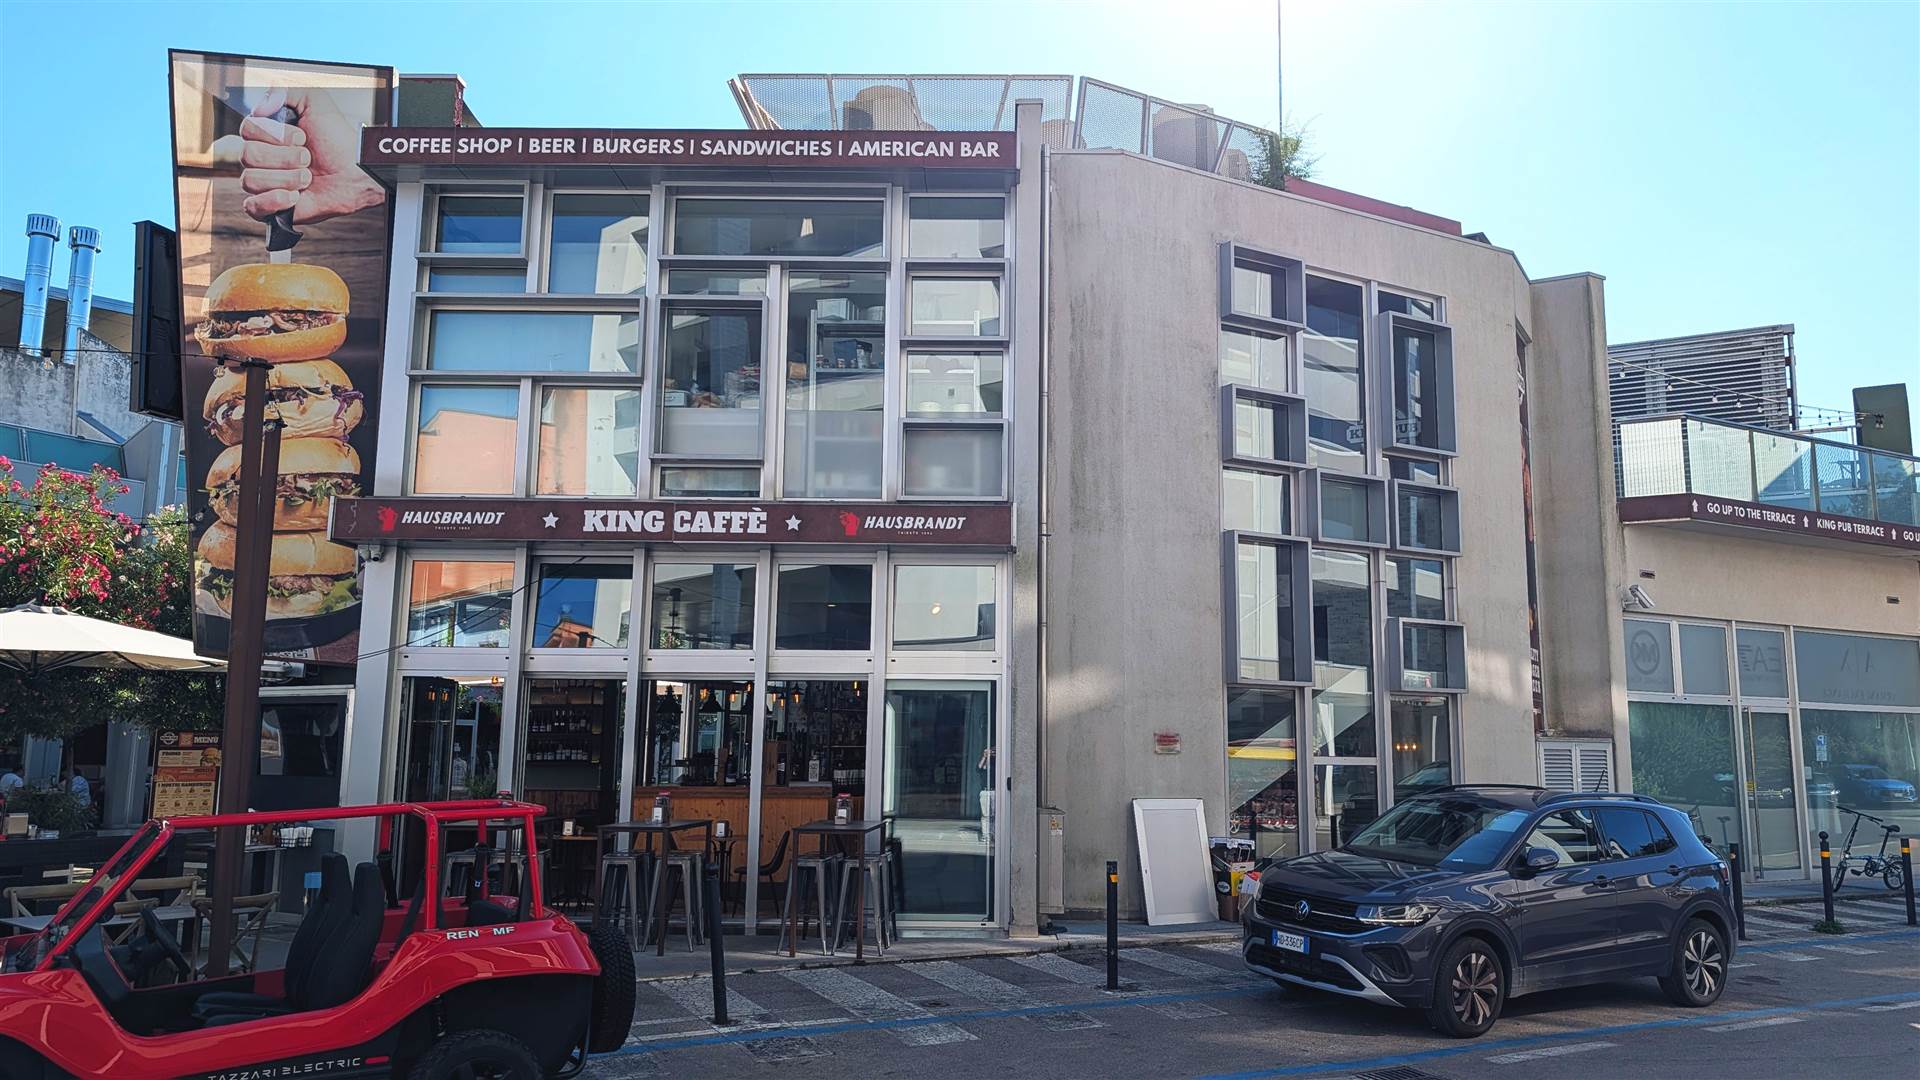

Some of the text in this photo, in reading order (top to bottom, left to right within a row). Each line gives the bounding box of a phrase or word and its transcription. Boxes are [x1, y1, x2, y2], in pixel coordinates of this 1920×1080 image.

[378, 138, 451, 154] COFFEE
[456, 137, 512, 154] SHOP
[529, 138, 576, 154] BEER
[593, 138, 684, 155] BURGERS
[700, 139, 832, 156] SANDWICHES
[848, 140, 954, 157] AMERICAN
[960, 141, 1000, 157] BAR
[401, 511, 506, 525] HAUSBRANDT
[583, 507, 768, 534] KING CAFFÈ
[864, 516, 967, 530] HAUSBRANDT
[1706, 502, 1920, 543] GO UP TO THE TERRACE KING PUB TERRACE GO U
[446, 926, 515, 940] REN MF
[282, 1057, 361, 1075] ELECTRIC
